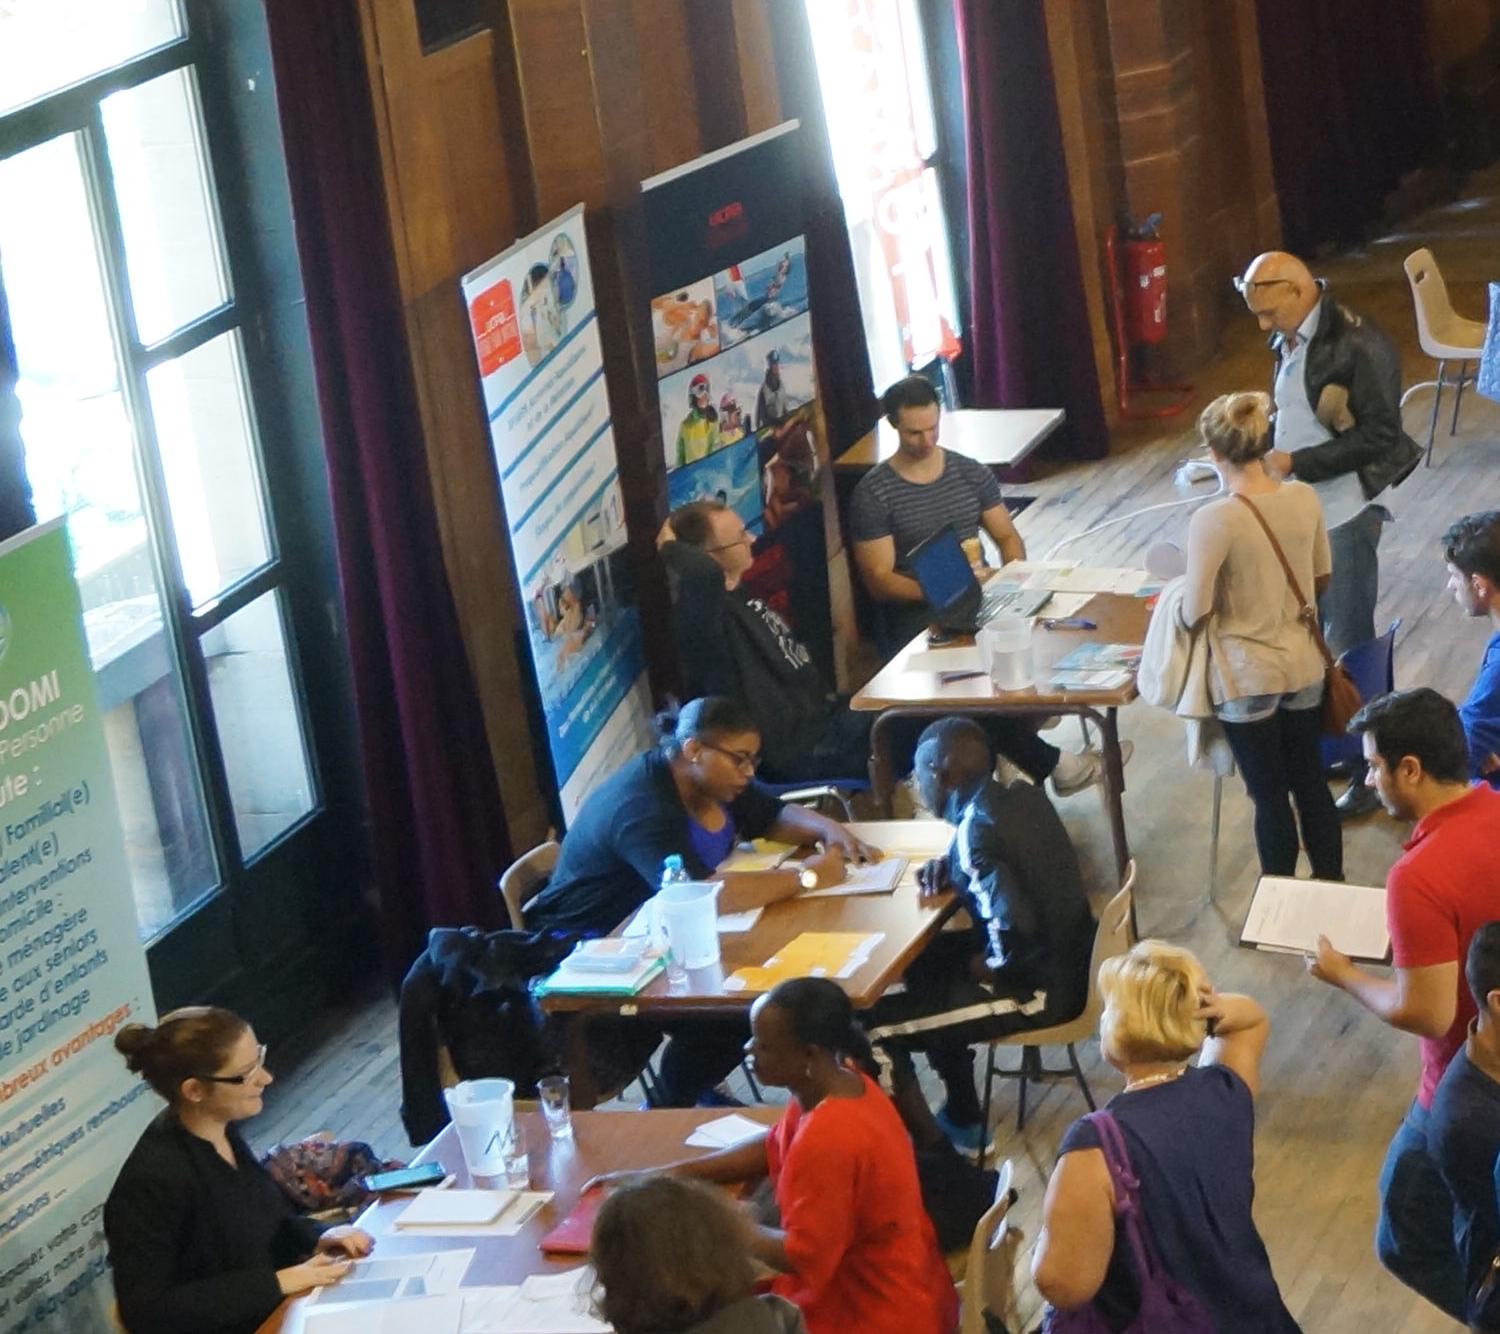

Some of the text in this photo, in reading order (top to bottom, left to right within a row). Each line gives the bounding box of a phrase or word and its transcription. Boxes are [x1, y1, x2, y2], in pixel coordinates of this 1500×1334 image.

[12, 965, 43, 994] aux
[15, 987, 92, 1054] jardinage
[51, 1002, 133, 1067] avantages
